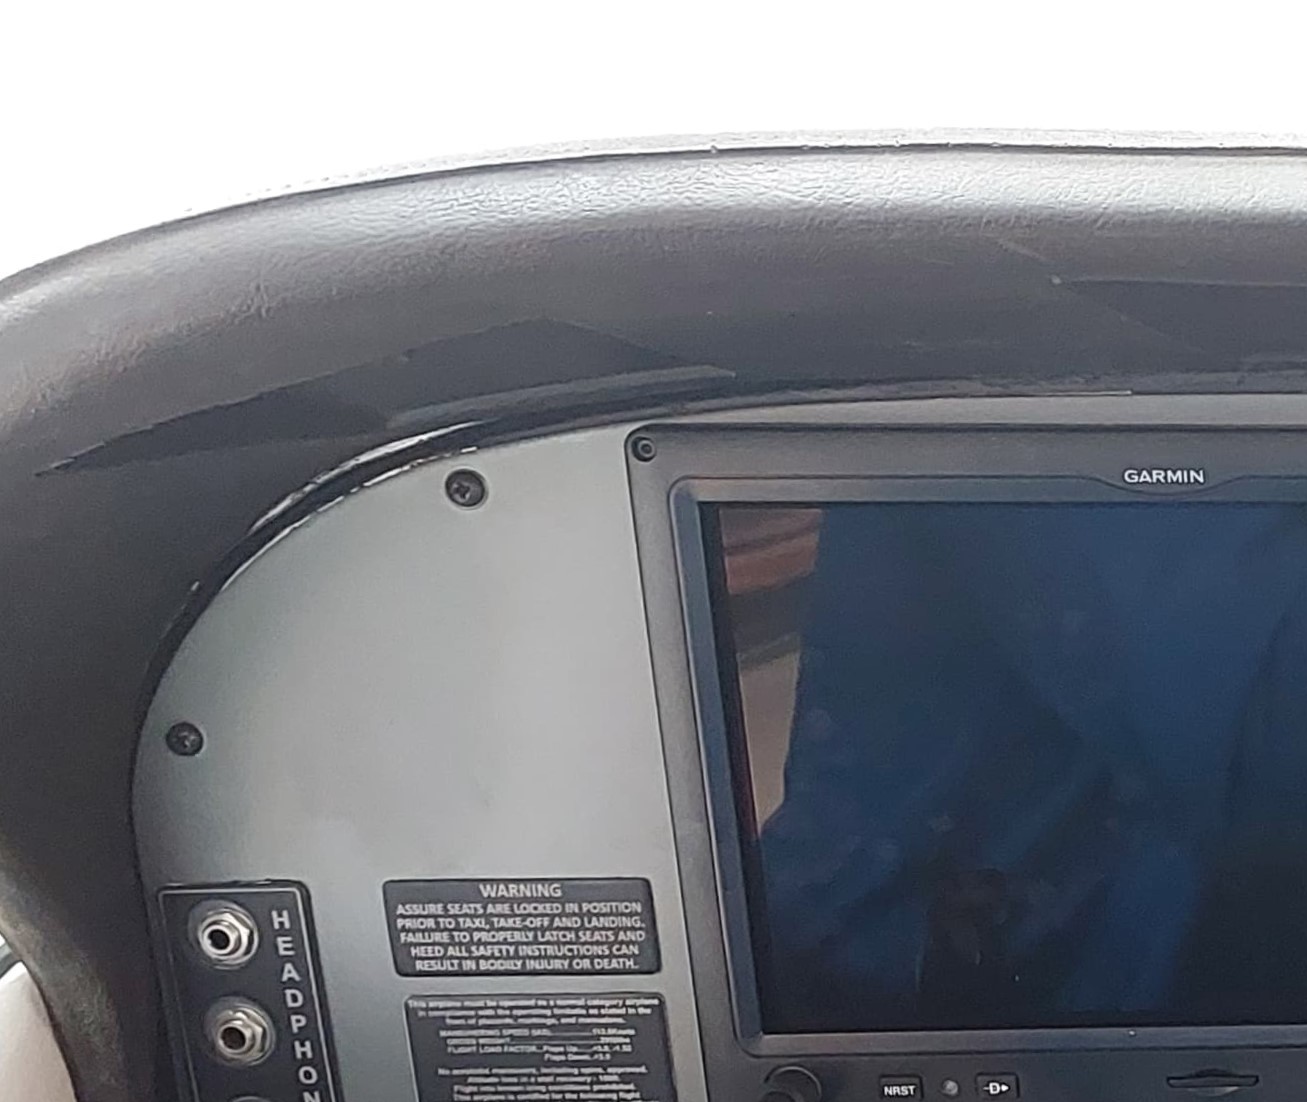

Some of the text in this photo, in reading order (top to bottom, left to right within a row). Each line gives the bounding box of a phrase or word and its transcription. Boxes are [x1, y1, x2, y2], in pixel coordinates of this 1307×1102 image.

[1124, 470, 1204, 483] GARMIN
[479, 884, 562, 897] WARNING
[396, 902, 641, 915] ASSURE SEATS ARE LOCKED IN POSITION
[884, 1086, 916, 1096] NRST
